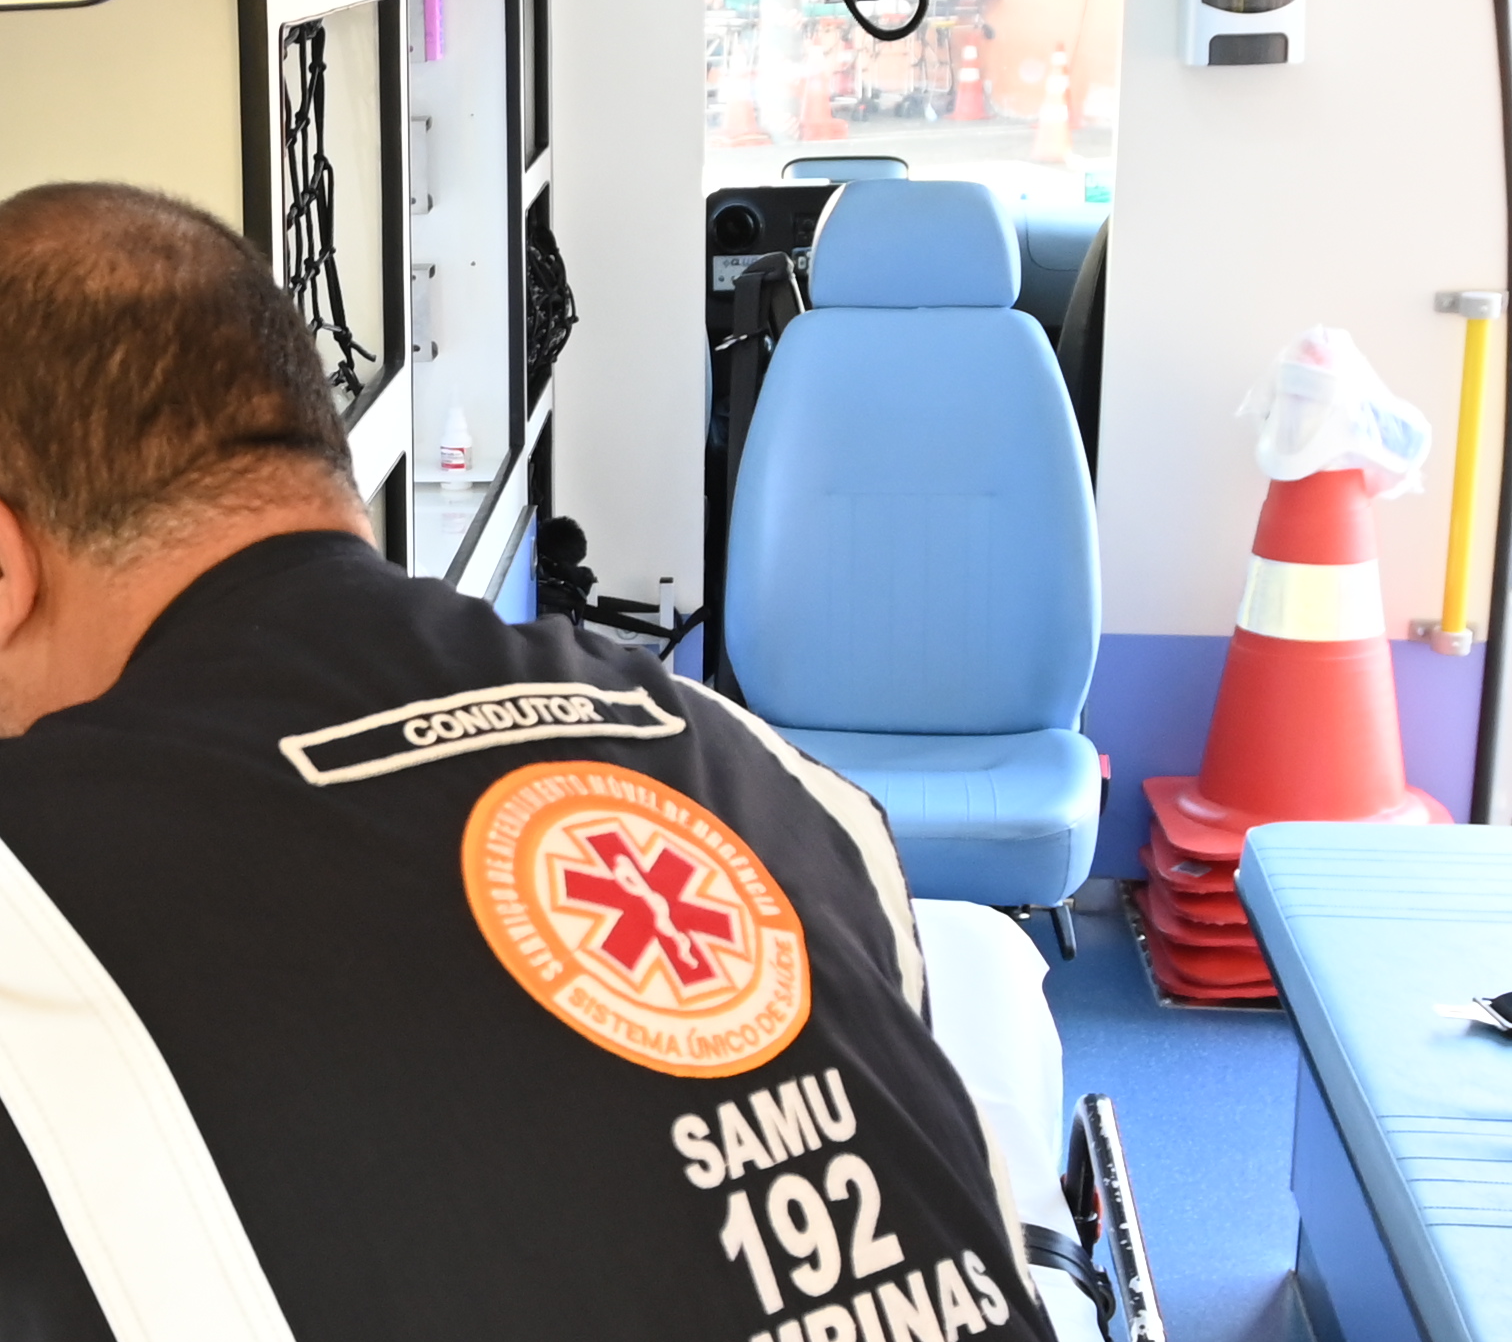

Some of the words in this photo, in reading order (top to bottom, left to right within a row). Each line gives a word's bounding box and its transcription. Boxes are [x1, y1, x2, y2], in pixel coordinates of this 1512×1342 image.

[403, 692, 604, 746] CONDUTOR
[587, 773, 659, 812] MÓVEL
[662, 800, 691, 829] DE
[692, 819, 782, 916] URGÊNCIA
[568, 987, 681, 1058] SISTEMA
[688, 1024, 760, 1060] ÚNICO
[755, 1001, 786, 1034] DE
[771, 937, 794, 1006] SAÚDE
[671, 1066, 857, 1189] SAMU
[719, 1153, 906, 1315] 192
